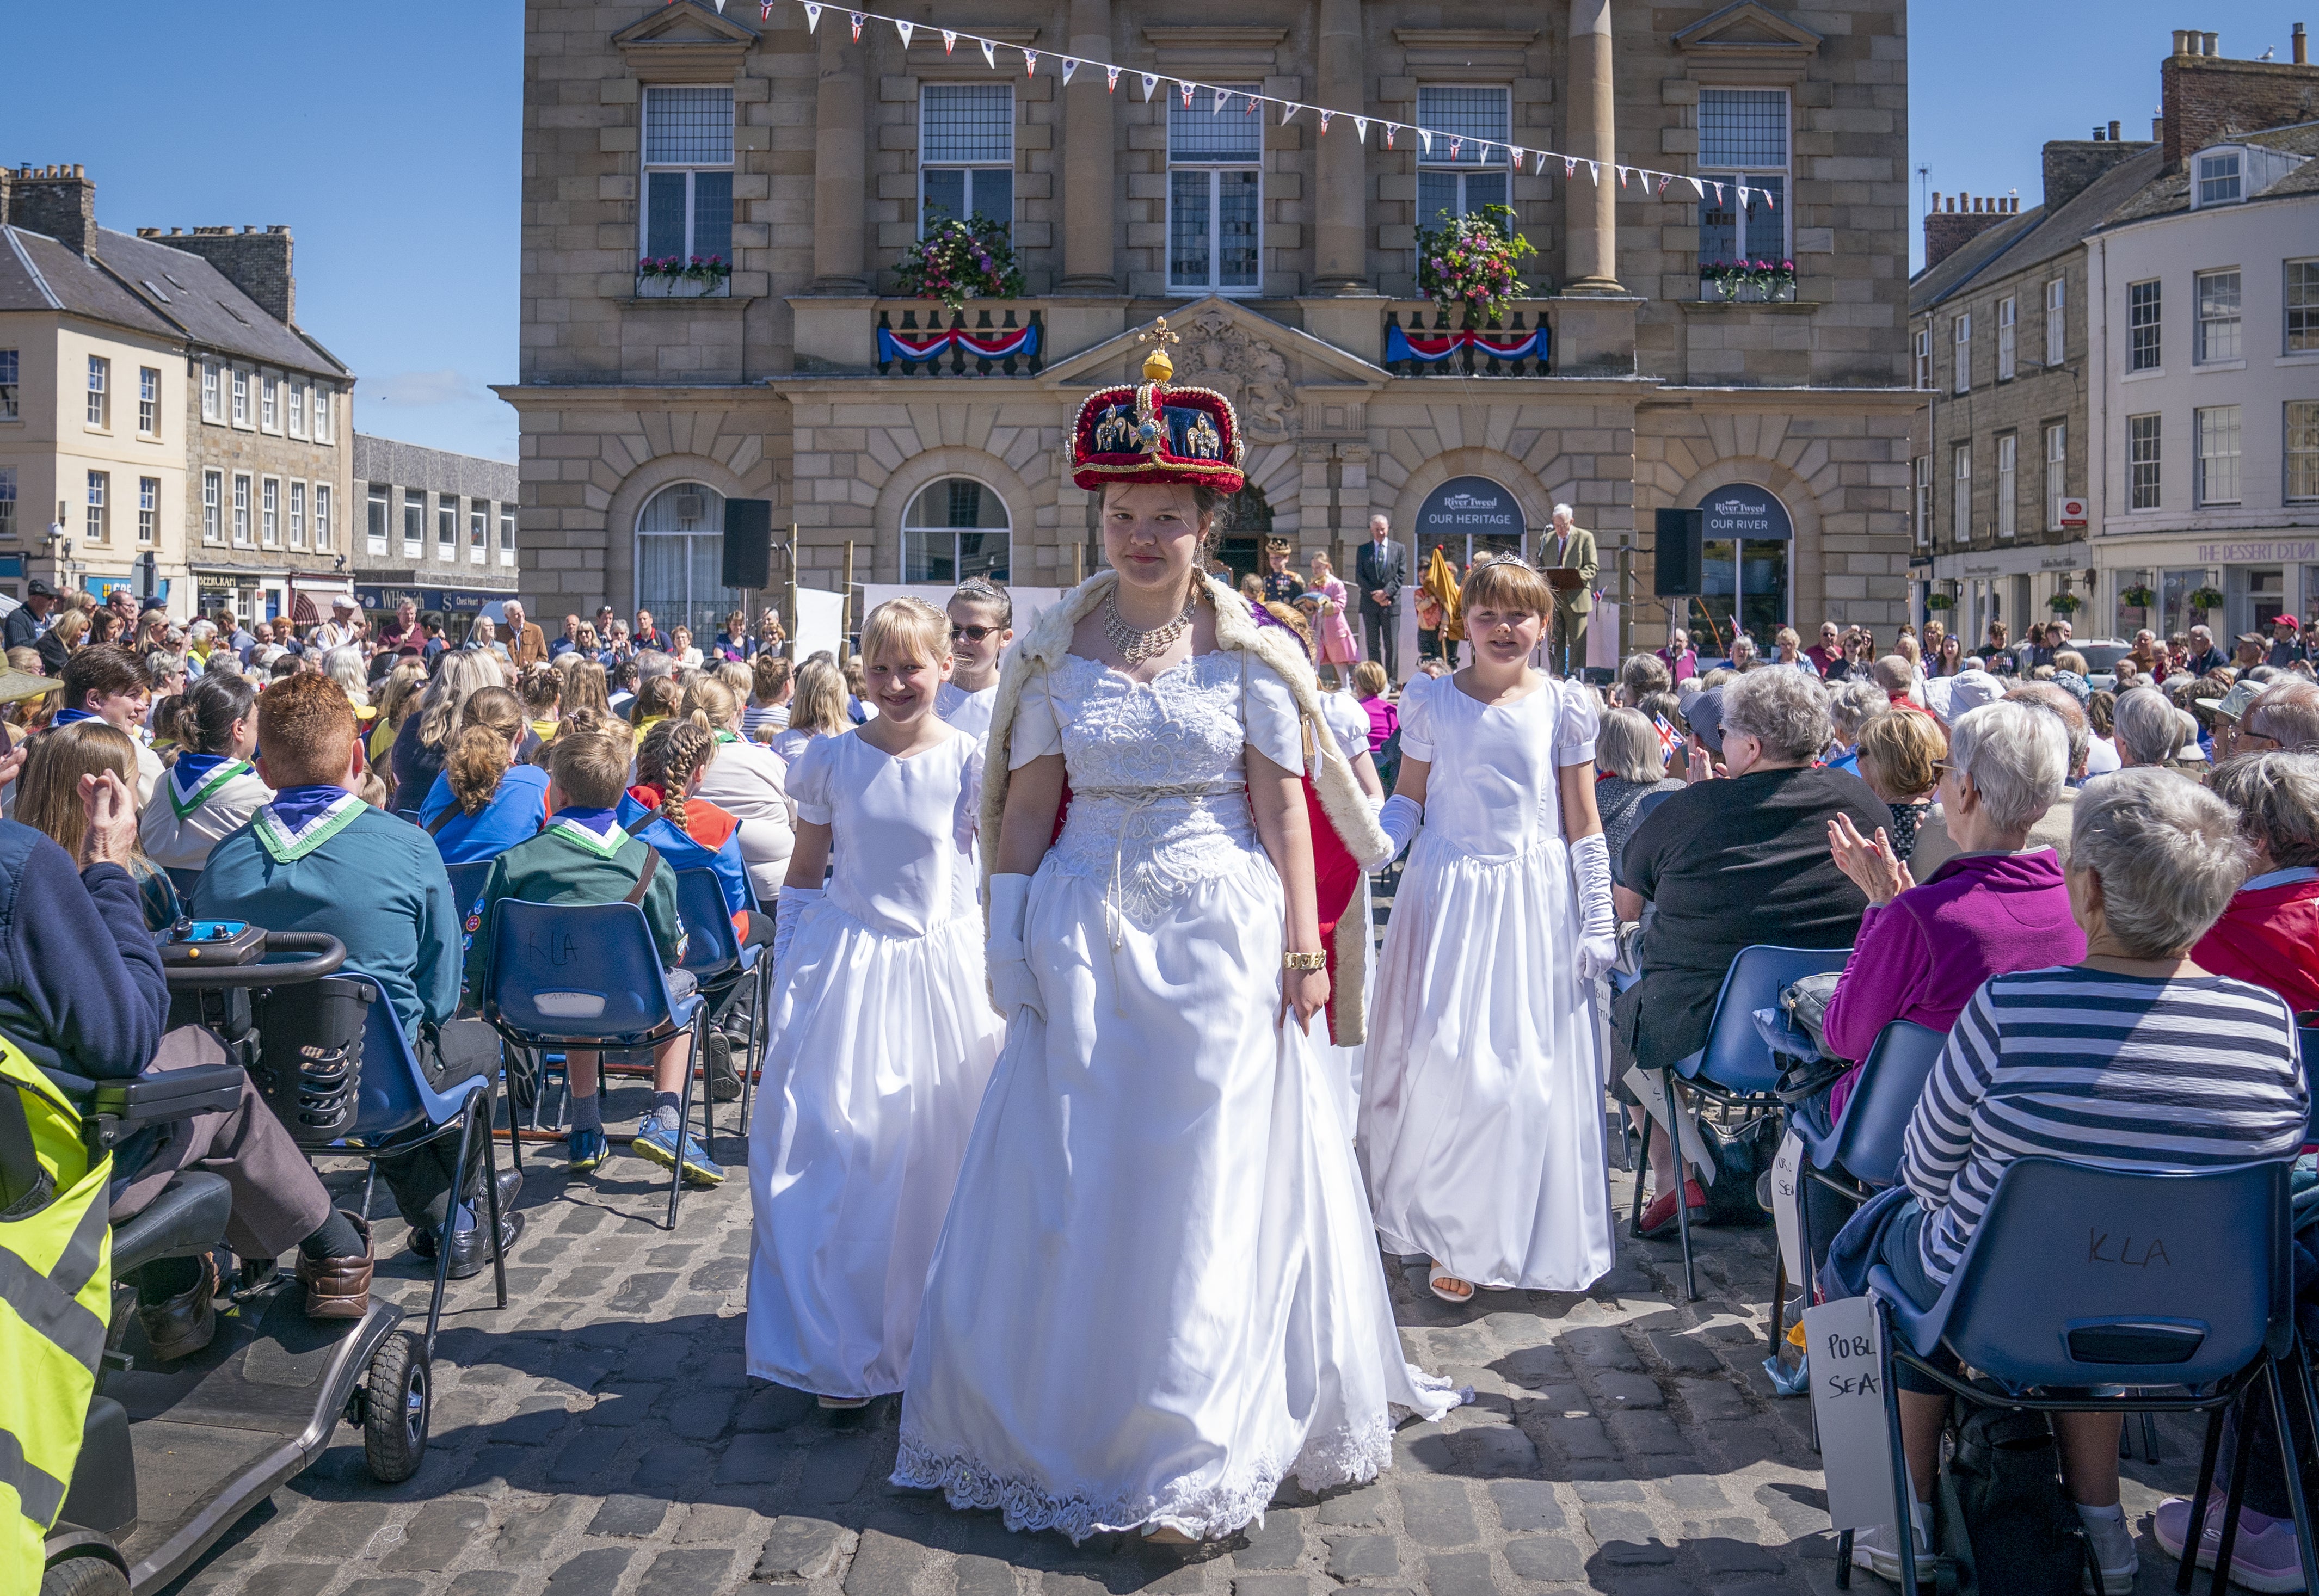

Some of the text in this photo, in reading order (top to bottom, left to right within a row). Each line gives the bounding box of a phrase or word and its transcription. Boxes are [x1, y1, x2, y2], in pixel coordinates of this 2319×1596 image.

[1444, 496, 1497, 510] River Tweed
[1715, 503, 1766, 515] River Tweed
[1429, 514, 1510, 525] OUR HERITAGE
[1711, 519, 1768, 530] OUR RIVER
[2197, 542, 2316, 561] THE DESSERT DIVA
[198, 575, 236, 587] BEERCRAFT
[381, 590, 425, 609] WHSith
[528, 930, 579, 966] KLA
[2088, 1227, 2172, 1268] KLA
